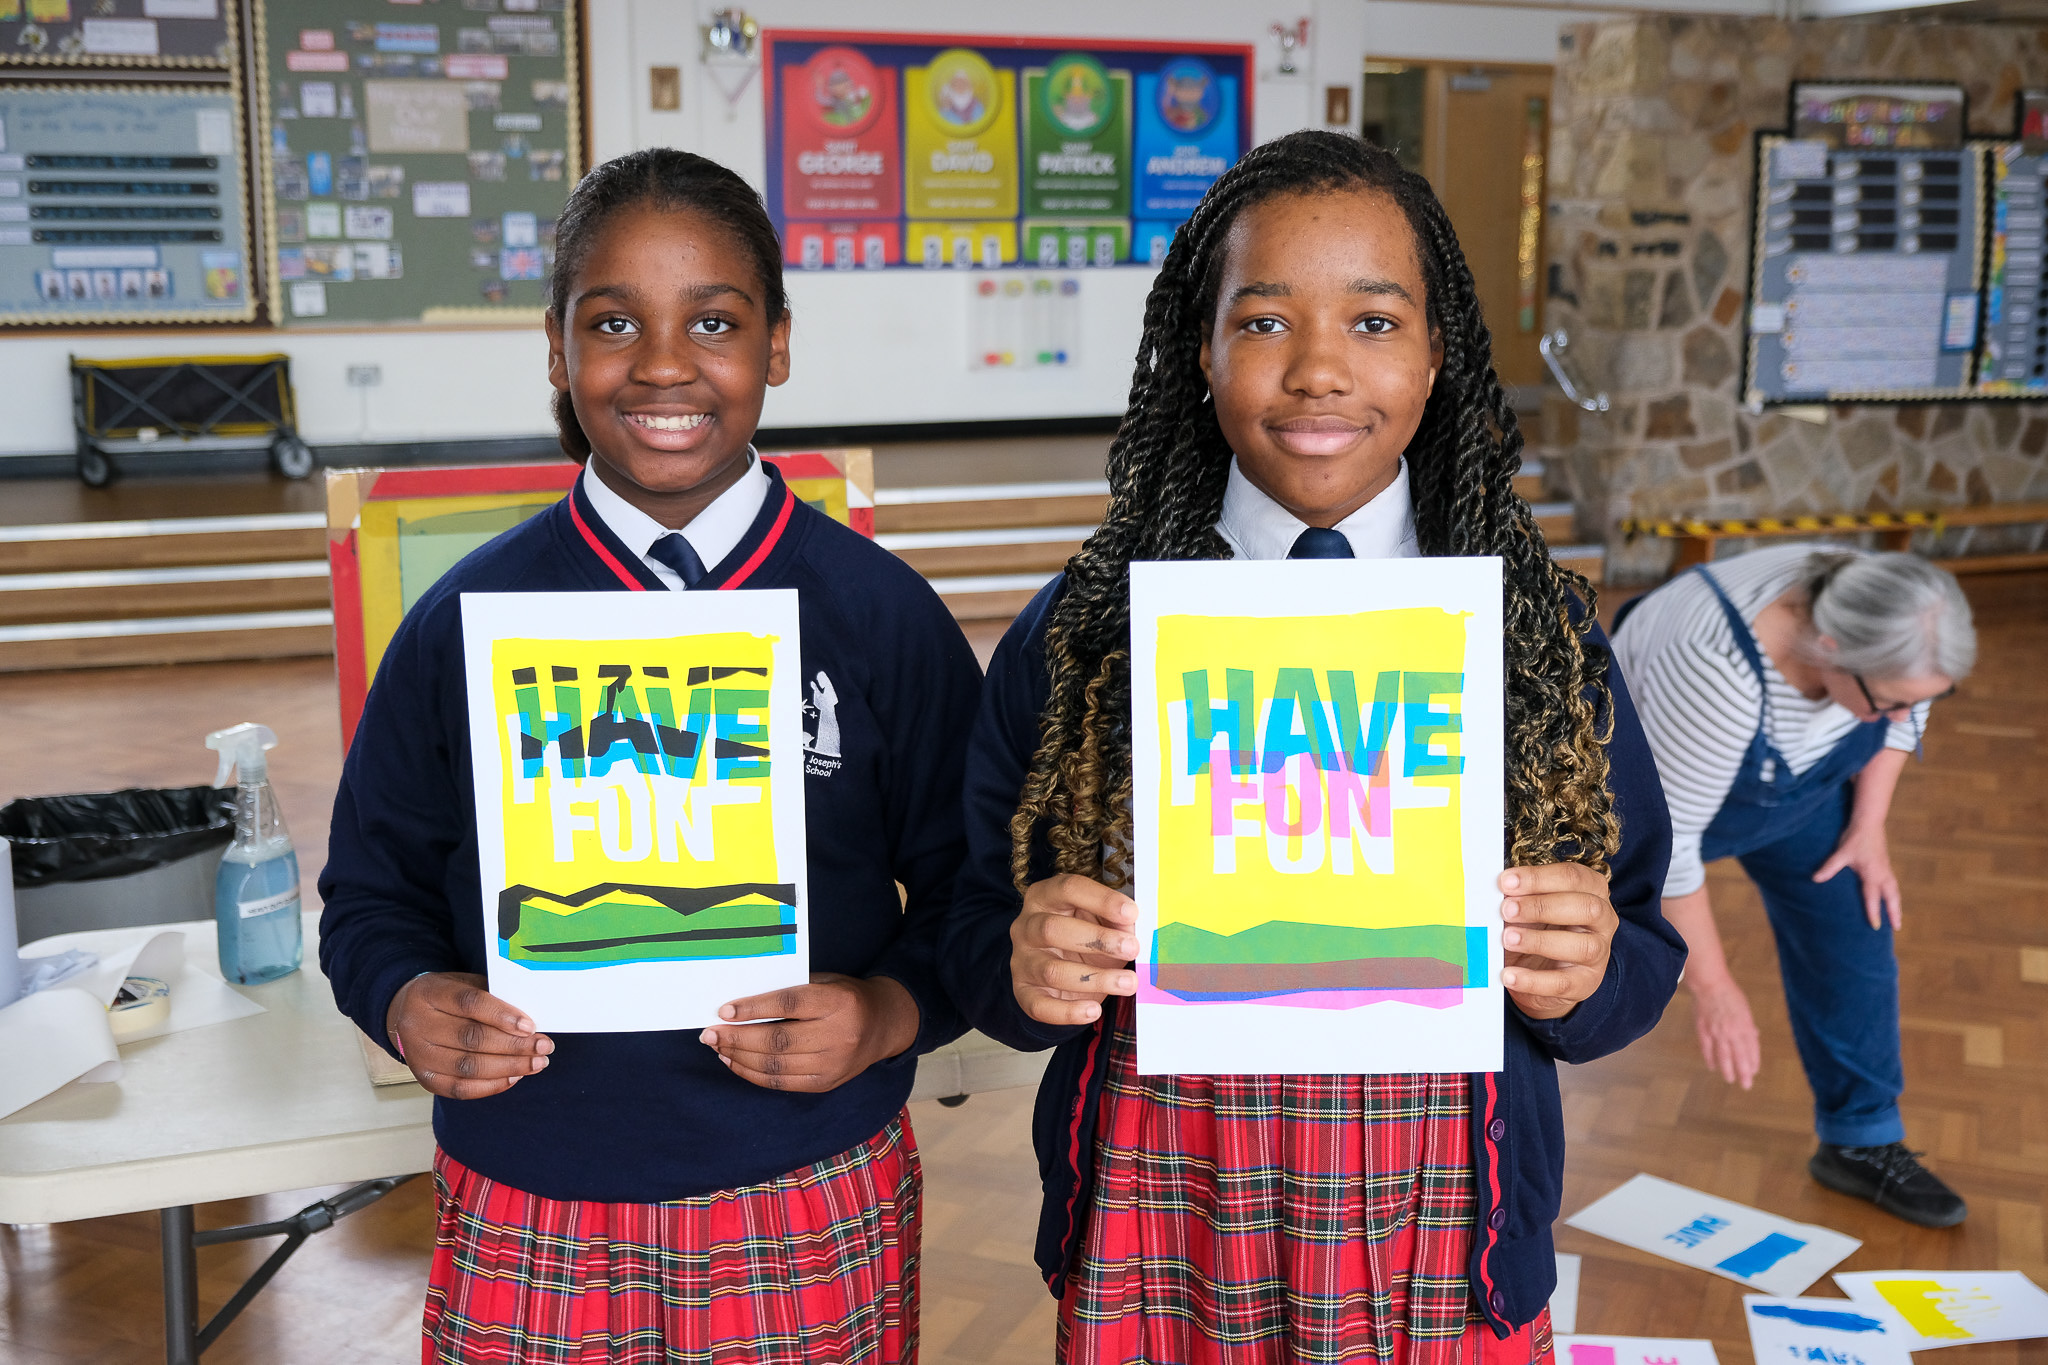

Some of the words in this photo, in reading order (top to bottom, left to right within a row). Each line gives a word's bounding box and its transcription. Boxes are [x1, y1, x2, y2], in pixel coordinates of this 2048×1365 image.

[798, 151, 884, 174] GEORGE
[930, 151, 994, 173] DAVID
[1037, 153, 1116, 175] PATRICK
[508, 665, 772, 780] HAVE
[1181, 667, 1466, 778] HAVE
[805, 764, 833, 777] School
[809, 754, 842, 769] Joseph's
[1207, 750, 1394, 874] FUN
